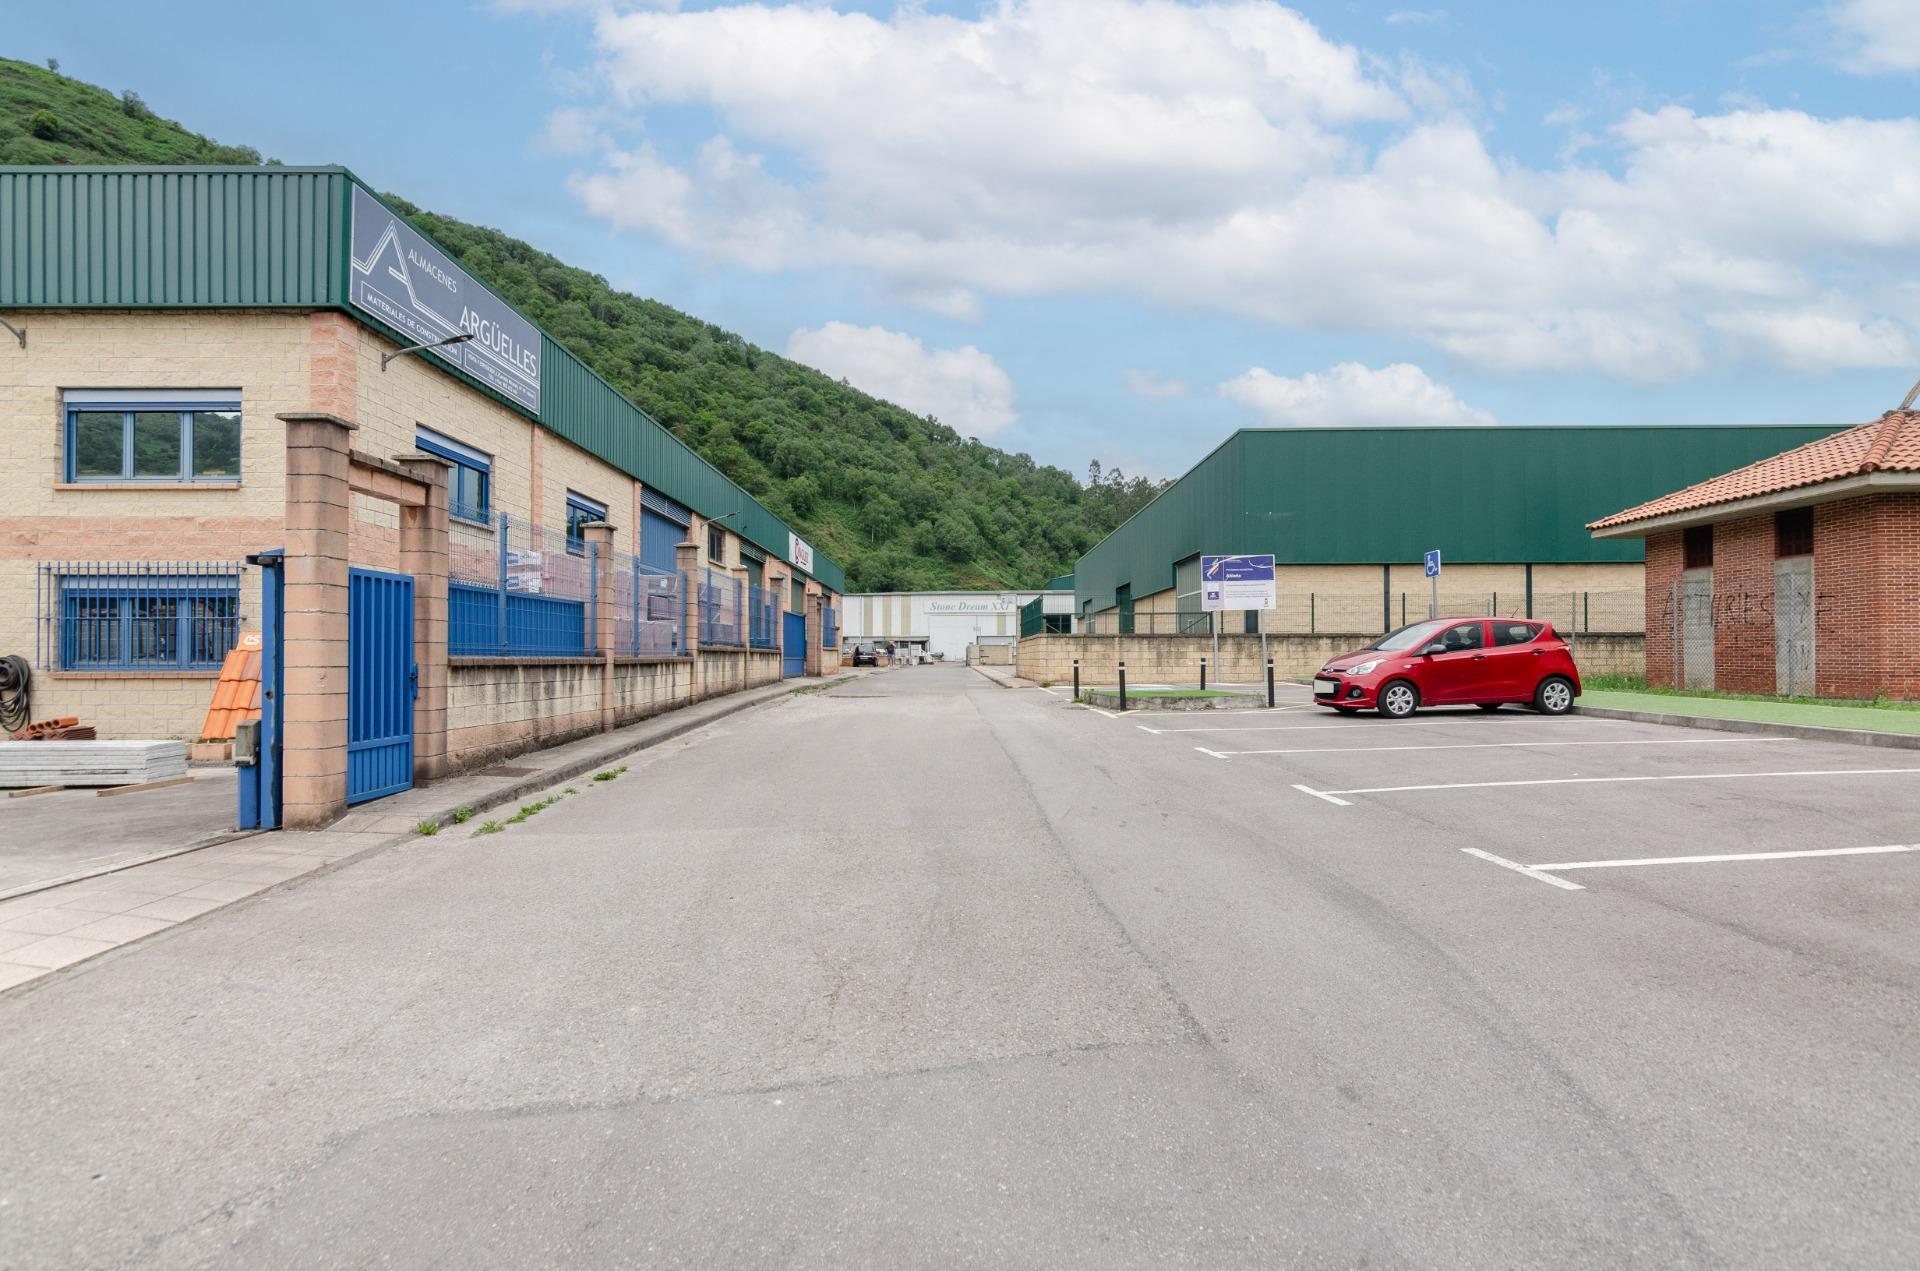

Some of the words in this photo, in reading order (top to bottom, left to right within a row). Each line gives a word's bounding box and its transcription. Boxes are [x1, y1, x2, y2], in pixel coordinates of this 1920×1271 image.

[408, 248, 457, 293] ALMACENES
[366, 292, 406, 324] MATERIALES
[407, 318, 416, 330] DE
[416, 324, 458, 356] CONSTRUCIÓN
[460, 305, 537, 377] ARGÜELLES
[930, 601, 956, 611] Stone
[958, 601, 988, 611] Dream
